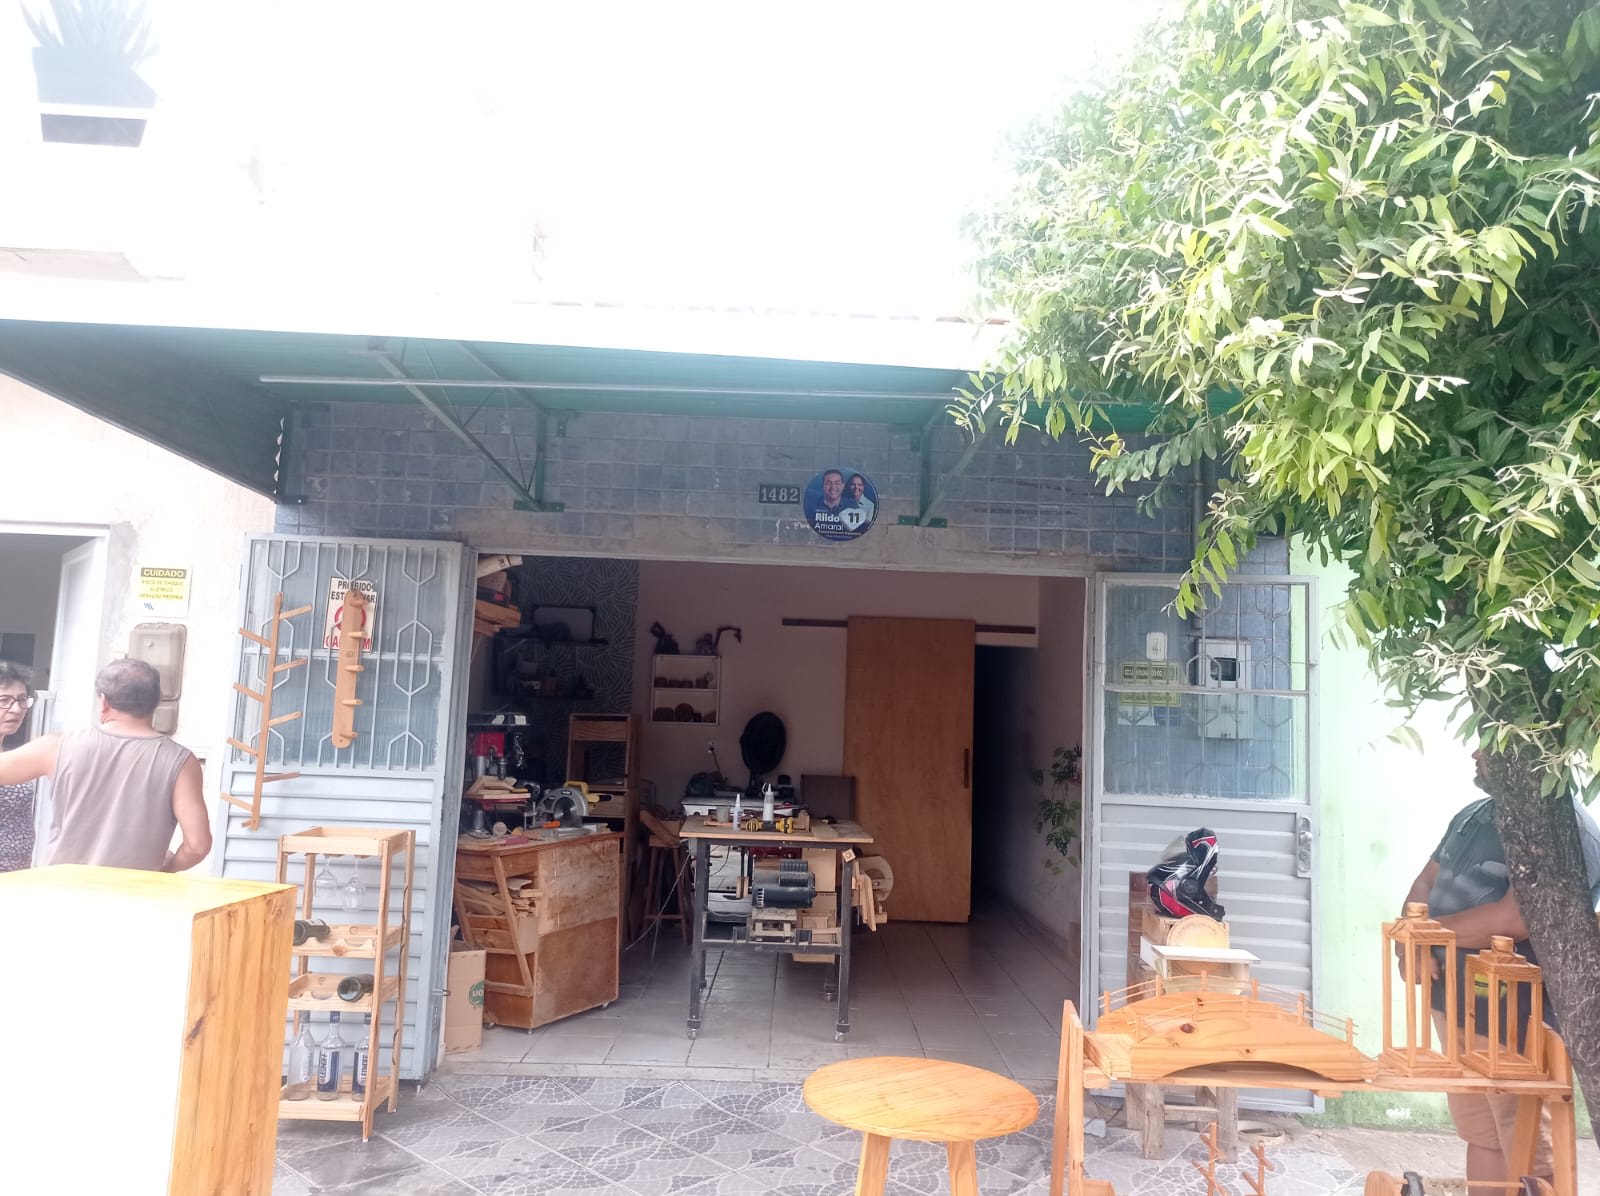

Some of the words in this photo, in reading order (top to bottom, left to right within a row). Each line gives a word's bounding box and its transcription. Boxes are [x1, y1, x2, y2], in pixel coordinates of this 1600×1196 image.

[761, 487, 799, 502] 1482
[815, 512, 840, 523] Rildo
[848, 512, 860, 524] 11
[814, 522, 844, 532] Amaral
[143, 568, 185, 578] CUIDADO
[331, 591, 376, 604] ESTNAR
